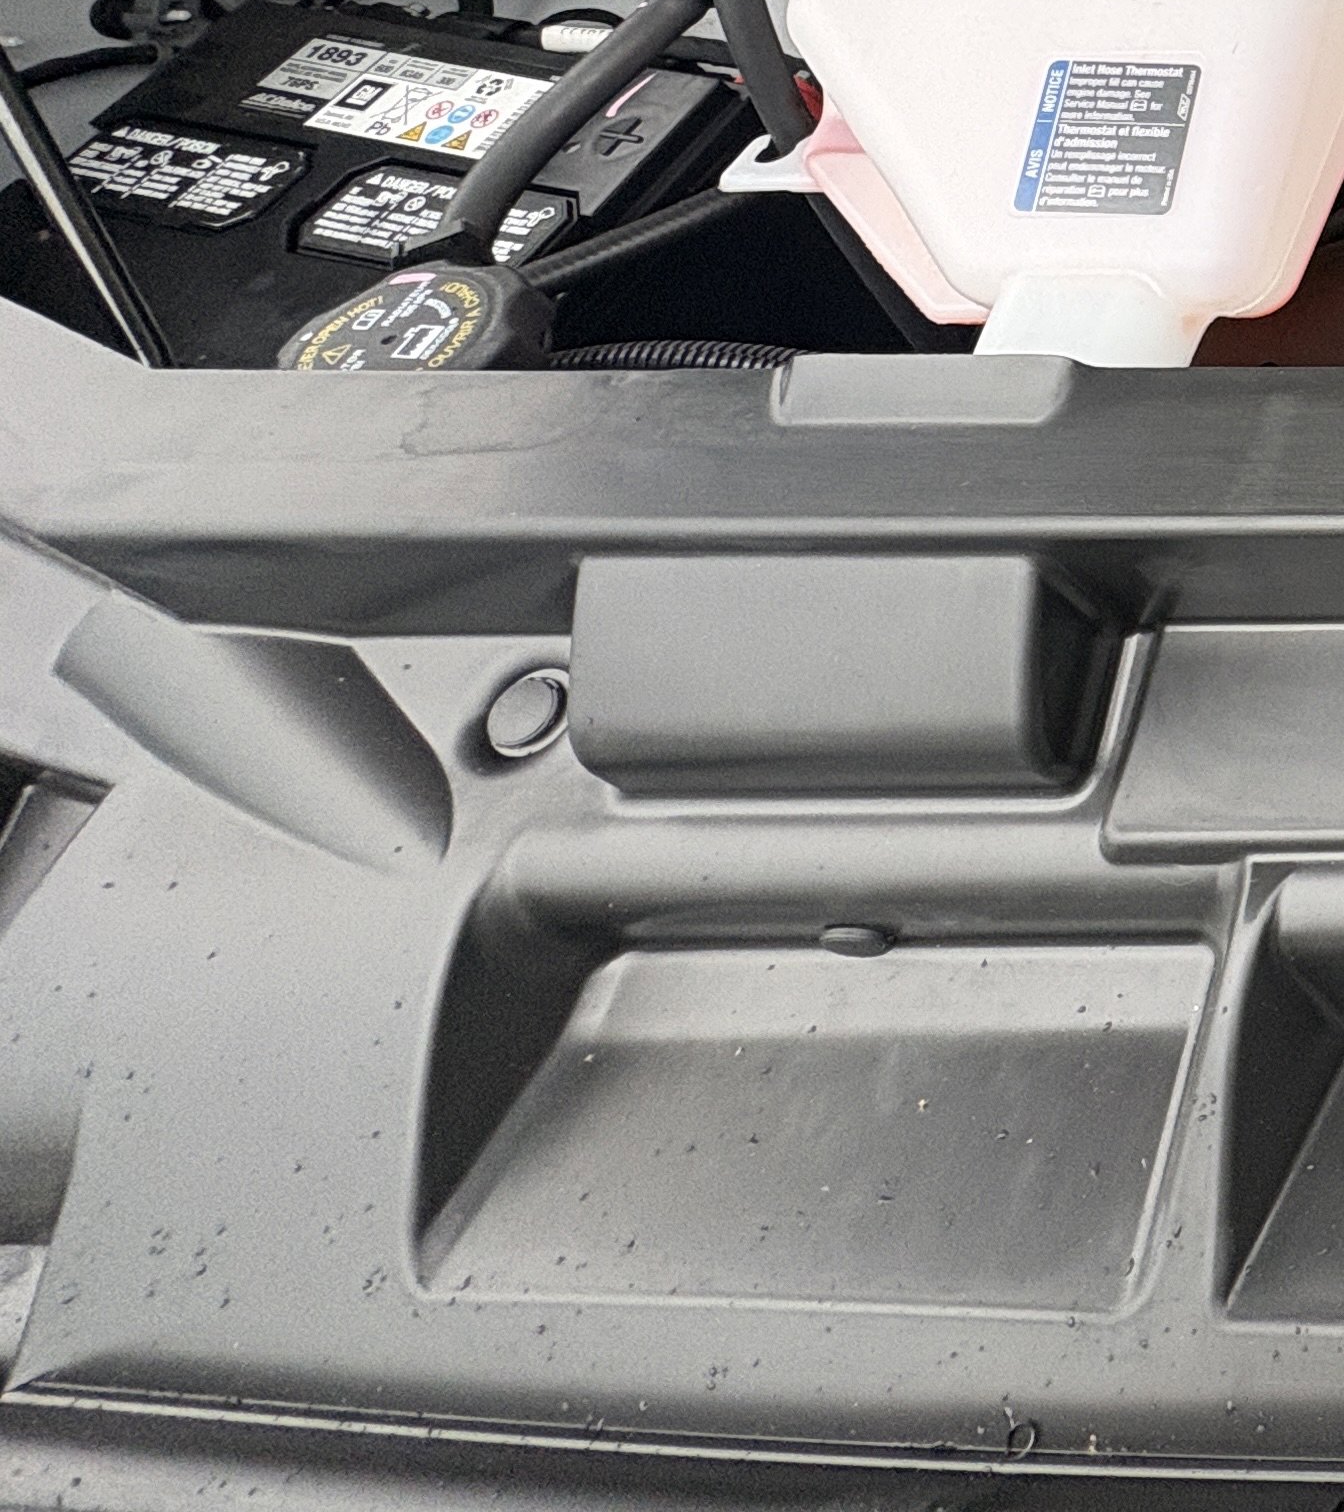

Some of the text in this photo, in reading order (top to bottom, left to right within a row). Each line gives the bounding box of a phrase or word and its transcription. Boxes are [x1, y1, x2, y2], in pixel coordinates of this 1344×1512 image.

[306, 44, 368, 66] 1893
[1072, 63, 1184, 78] Inlet Hose Thermostat
[1041, 69, 1064, 113] NOTICE
[1063, 99, 1163, 111] Service Manual for
[365, 120, 391, 135] Pb
[1058, 124, 1170, 137] Thermostat et flexible
[1053, 137, 1118, 149] d'admission
[1051, 149, 1063, 159] Un
[1117, 151, 1156, 162] incorrect
[1025, 149, 1044, 178] AVIS
[313, 315, 347, 345] OPEN
